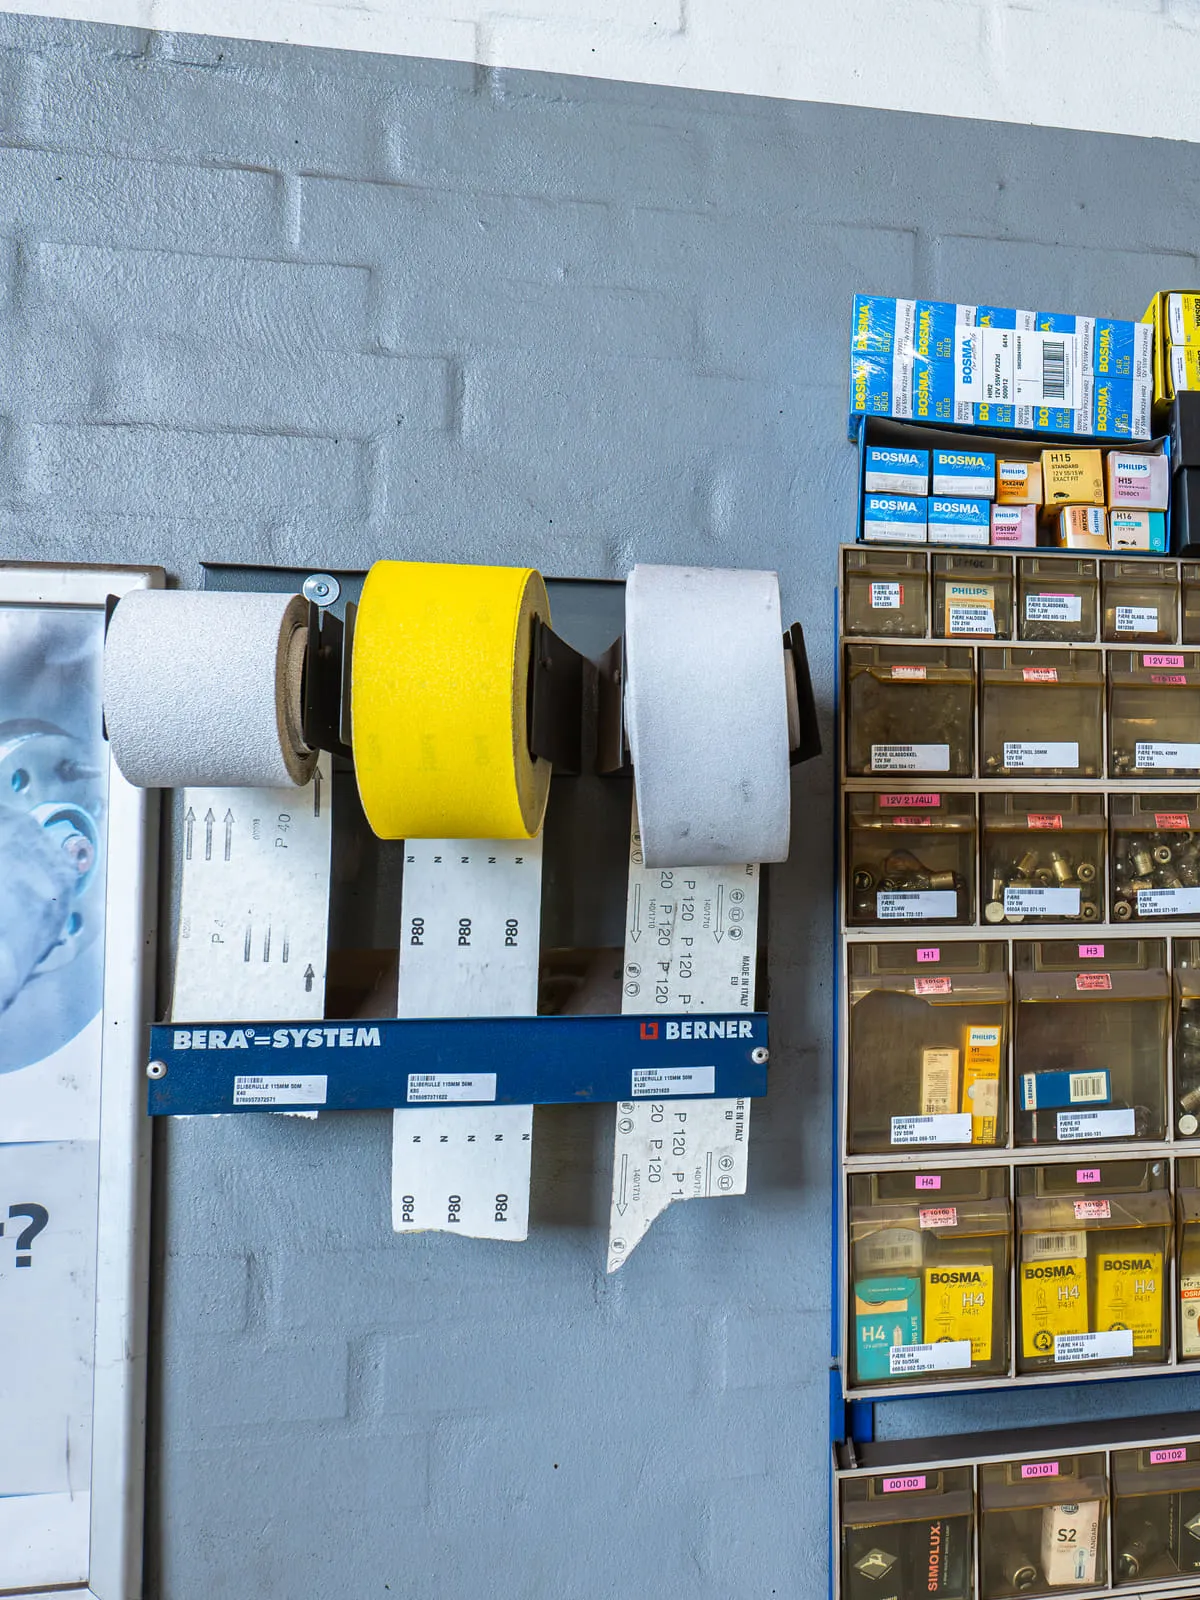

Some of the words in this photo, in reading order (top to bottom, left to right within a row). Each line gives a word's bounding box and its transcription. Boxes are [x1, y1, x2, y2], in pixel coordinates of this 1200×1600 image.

[919, 310, 930, 355] BOSMA
[1100, 329, 1110, 372] BOSMA
[963, 339, 972, 384] BOSMA
[918, 370, 929, 416] BOSMA
[1098, 387, 1108, 431] BOSMA
[871, 451, 918, 463] BOSMA
[939, 455, 984, 466] BOSMA
[1050, 454, 1071, 462] H15
[1117, 463, 1147, 471] PHILIPS
[870, 499, 917, 512] BOSMA
[933, 502, 980, 513] BOSMA
[952, 587, 988, 595] PHILIPS
[1149, 657, 1162, 665] 12V
[681, 898, 695, 921] 120
[411, 918, 424, 945] P80
[458, 918, 471, 946] P80
[505, 919, 518, 946] P80
[658, 922, 671, 946] 120
[680, 955, 692, 979] 120
[741, 955, 750, 976] MADE
[731, 977, 738, 986] EU
[742, 978, 749, 986] IN
[656, 981, 668, 1004] 120
[741, 988, 749, 1007] ITALY
[665, 1020, 754, 1040] BERNER
[402, 1195, 414, 1222] P80
[448, 1195, 460, 1222] P80
[495, 1194, 508, 1222] P80
[1025, 1266, 1074, 1279] BOSMA
[1104, 1260, 1152, 1271] BOSMA
[930, 1272, 980, 1284] BOSMA
[1058, 1285, 1079, 1300] H4
[1135, 1280, 1156, 1294] H4
[962, 1292, 985, 1307] H4
[862, 1325, 886, 1342] H4
[1156, 1451, 1182, 1460] 00102
[1026, 1465, 1054, 1475] 00101
[890, 1479, 918, 1488] 00100
[1057, 1529, 1077, 1542] S2
